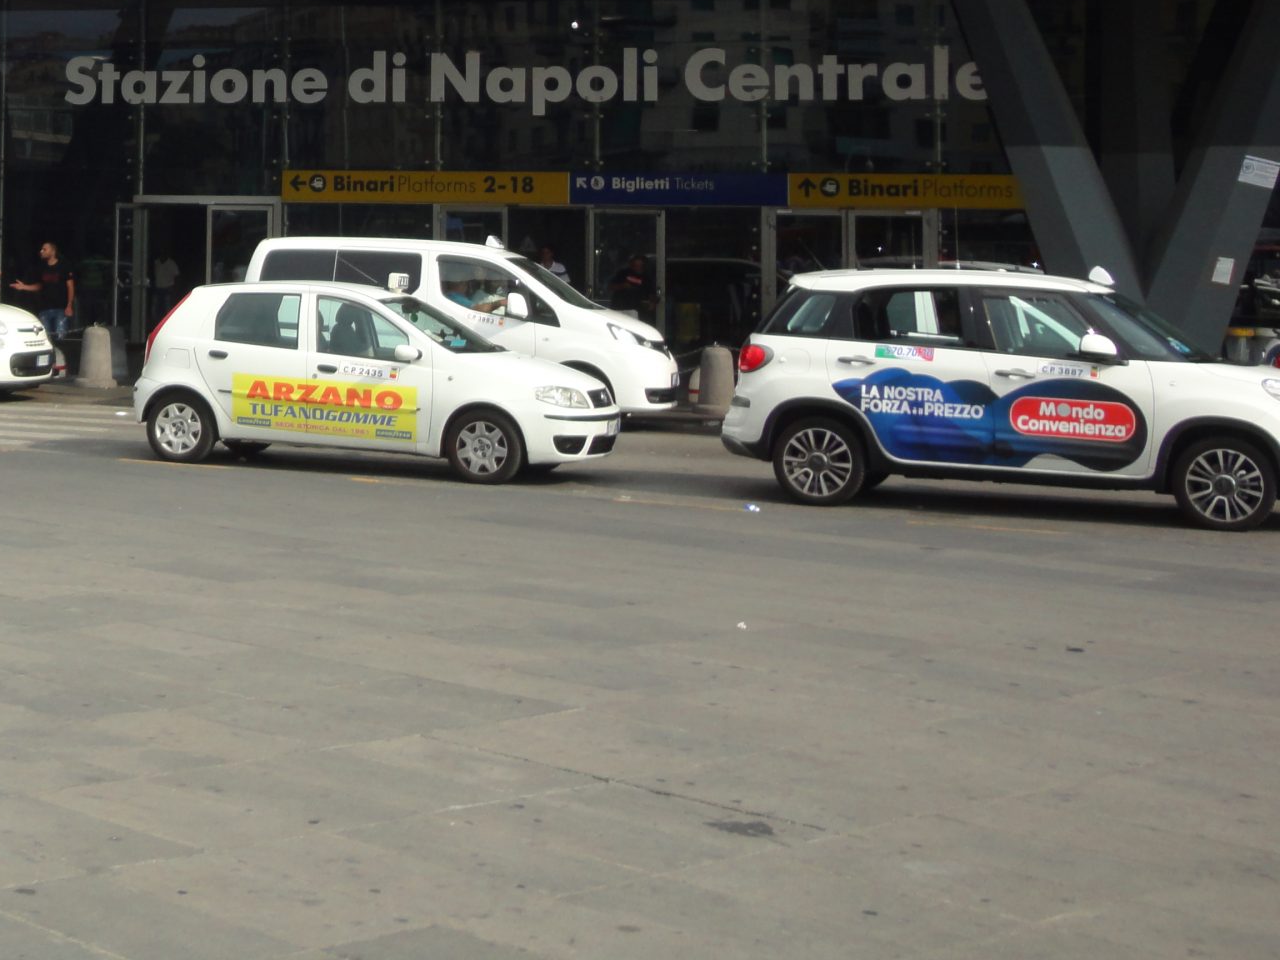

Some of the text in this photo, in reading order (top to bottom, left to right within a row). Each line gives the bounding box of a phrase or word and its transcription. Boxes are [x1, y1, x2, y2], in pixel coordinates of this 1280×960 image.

[64, 45, 988, 117] Stazione di Napoli Centrale
[333, 175, 535, 194] Binari Platforms 2-18
[611, 176, 715, 192] Biglietti Tickets
[847, 179, 1014, 199] Binari Platforms
[359, 367, 383, 378] 2435
[246, 380, 403, 411] ARZANO
[861, 384, 945, 402] LA NOSTRA
[249, 403, 398, 427] TUFANOGOMME
[860, 399, 911, 414] FORZA
[924, 402, 984, 419] PREZZO
[1017, 415, 1126, 437] Convenienza
